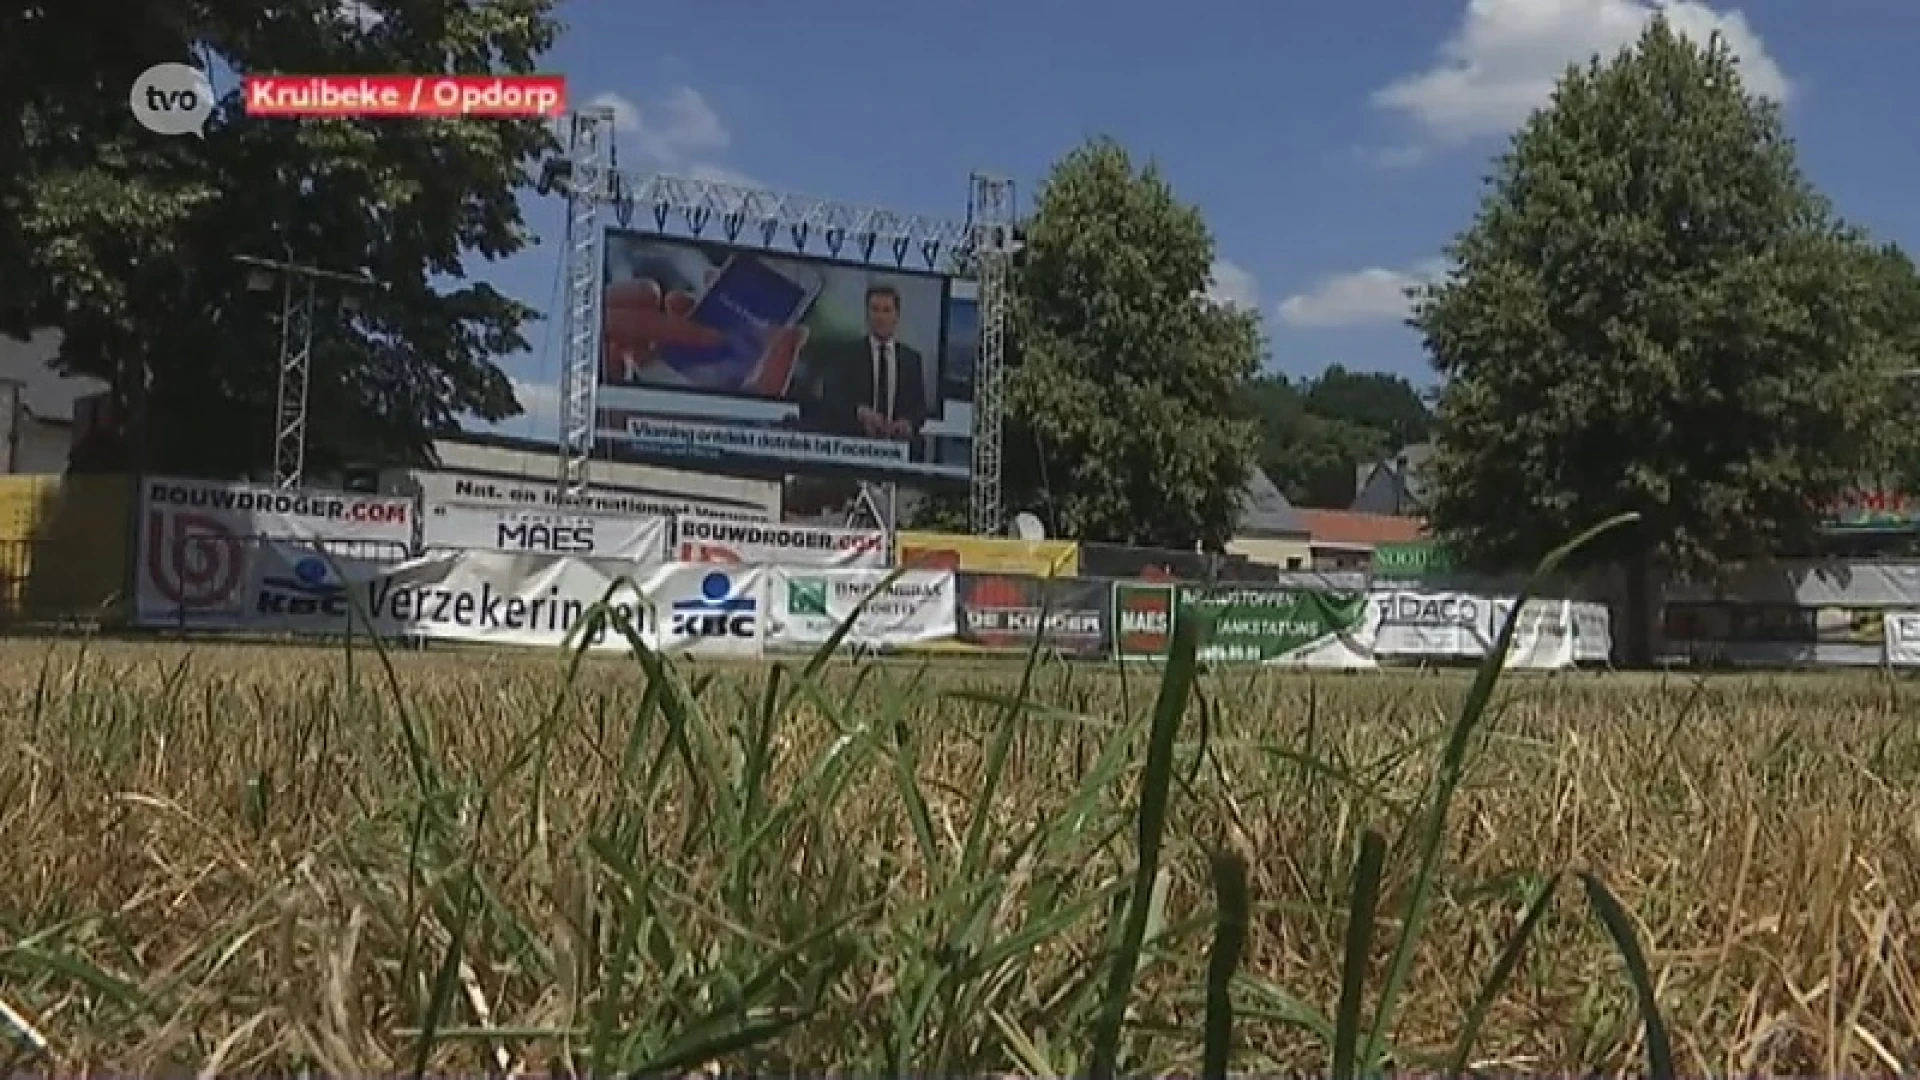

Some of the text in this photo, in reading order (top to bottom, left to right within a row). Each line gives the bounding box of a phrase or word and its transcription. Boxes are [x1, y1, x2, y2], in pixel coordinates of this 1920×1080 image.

[151, 486, 407, 524] BOUWDROGER.COM
[498, 523, 594, 551] MAES
[256, 591, 348, 616] KBC
[672, 612, 756, 638] KBC
[1120, 610, 1168, 634] MAES
